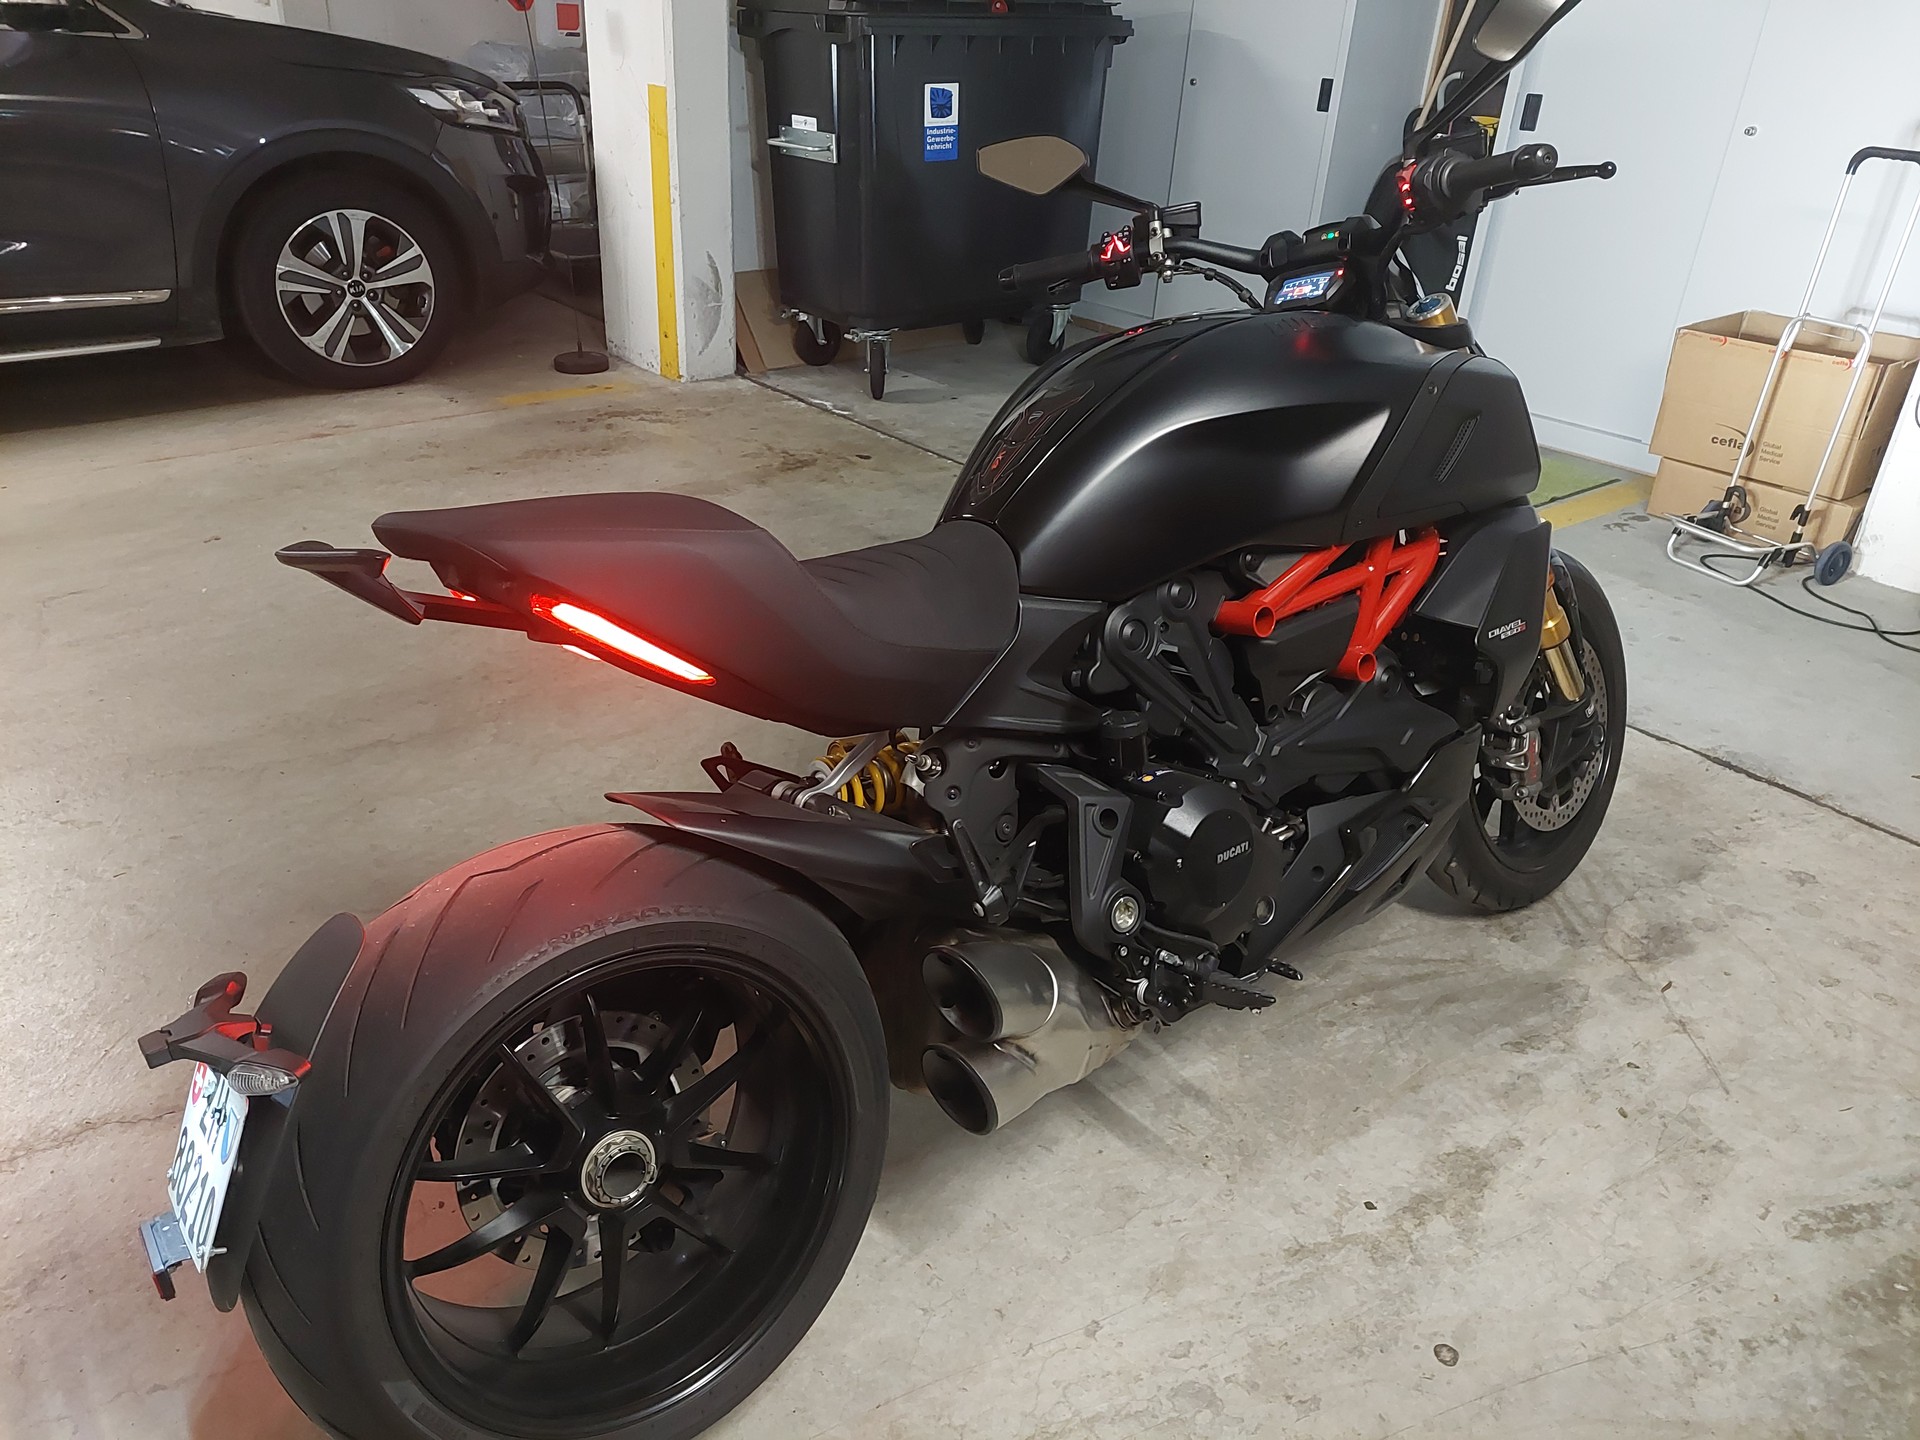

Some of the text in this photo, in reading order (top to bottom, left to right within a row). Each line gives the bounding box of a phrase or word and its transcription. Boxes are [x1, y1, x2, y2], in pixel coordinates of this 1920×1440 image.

[926, 127, 957, 136] Industrie-
[926, 134, 957, 143] Gewerbe-
[926, 142, 953, 151] kehricht
[1445, 235, 1469, 292] bosal
[349, 285, 365, 294] KIA
[1711, 435, 1745, 450] cefla
[1763, 441, 1782, 450] Global
[1760, 448, 1784, 458] Medical
[1758, 455, 1781, 465] Service
[1759, 506, 1779, 516] Global
[1757, 513, 1780, 524] Medical
[1755, 520, 1777, 530] Service
[1488, 619, 1526, 639] DIAVEL
[1216, 841, 1249, 864] DUCATI
